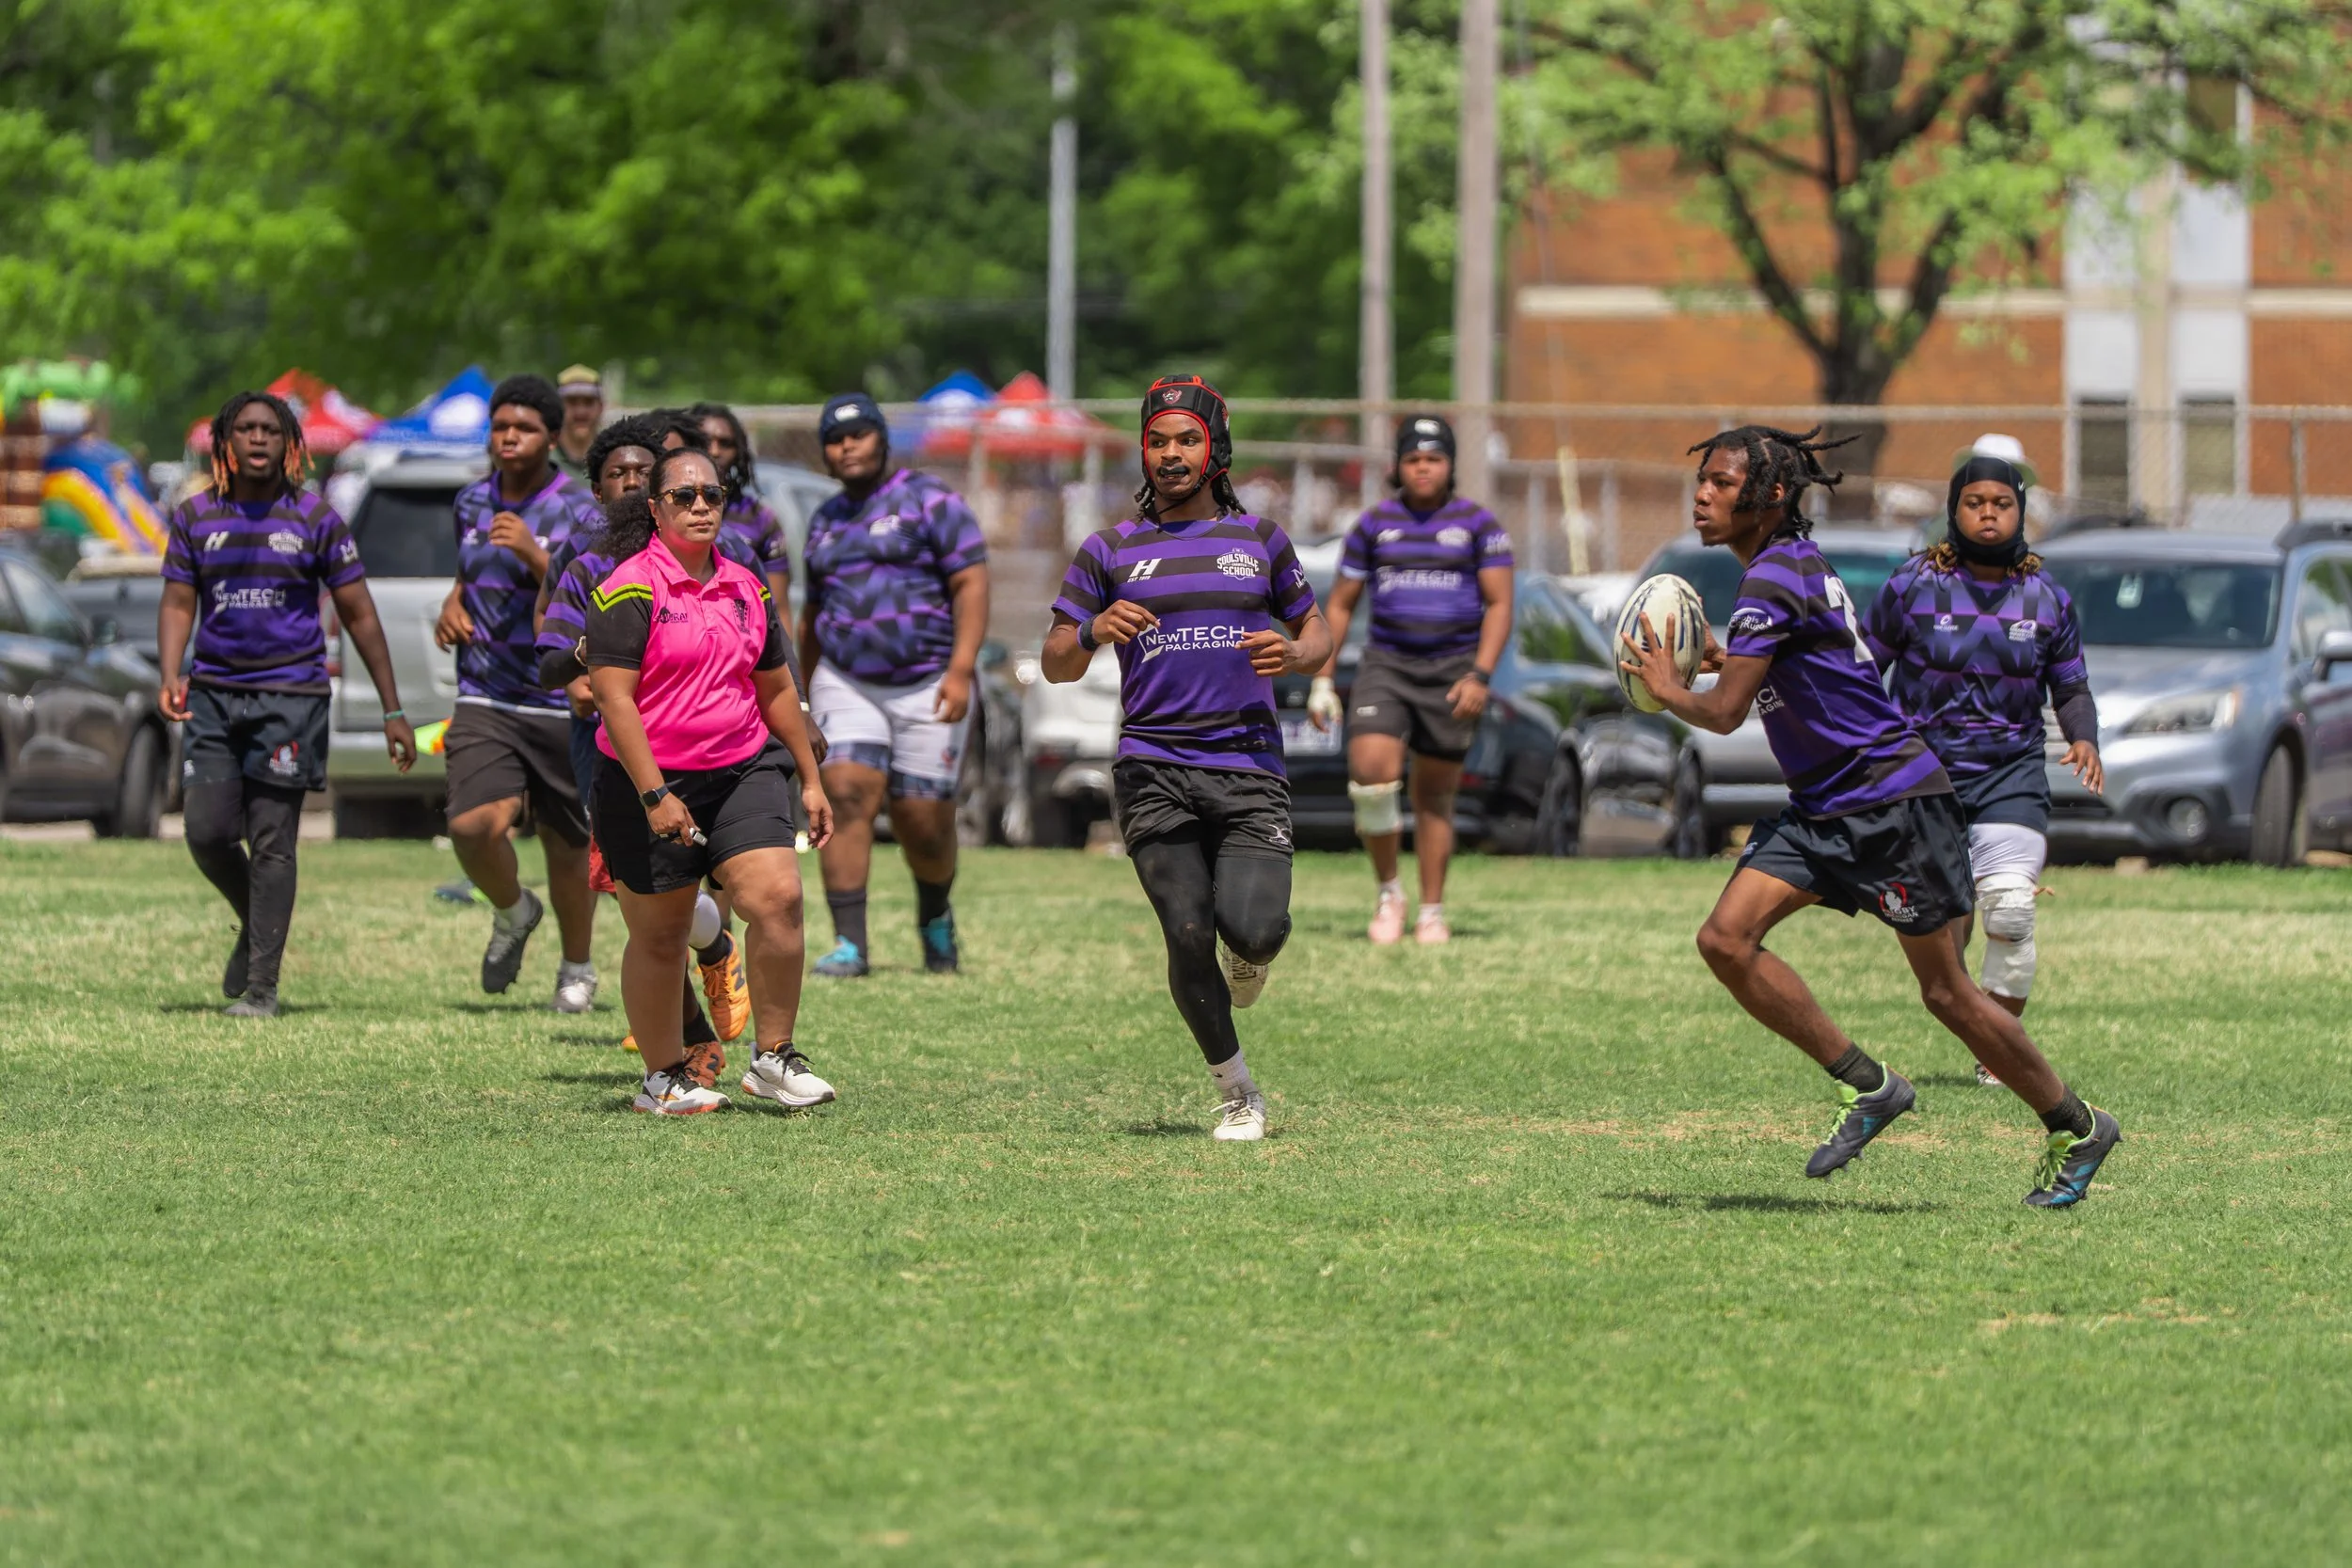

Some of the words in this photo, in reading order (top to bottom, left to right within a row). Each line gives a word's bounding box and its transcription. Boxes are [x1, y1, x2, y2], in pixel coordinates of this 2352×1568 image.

[1129, 558, 1162, 578] H
[1216, 553, 1260, 572] SOULSVILLE
[1223, 566, 1256, 577] SCHOOL
[1146, 626, 1245, 646] NEWTECH
